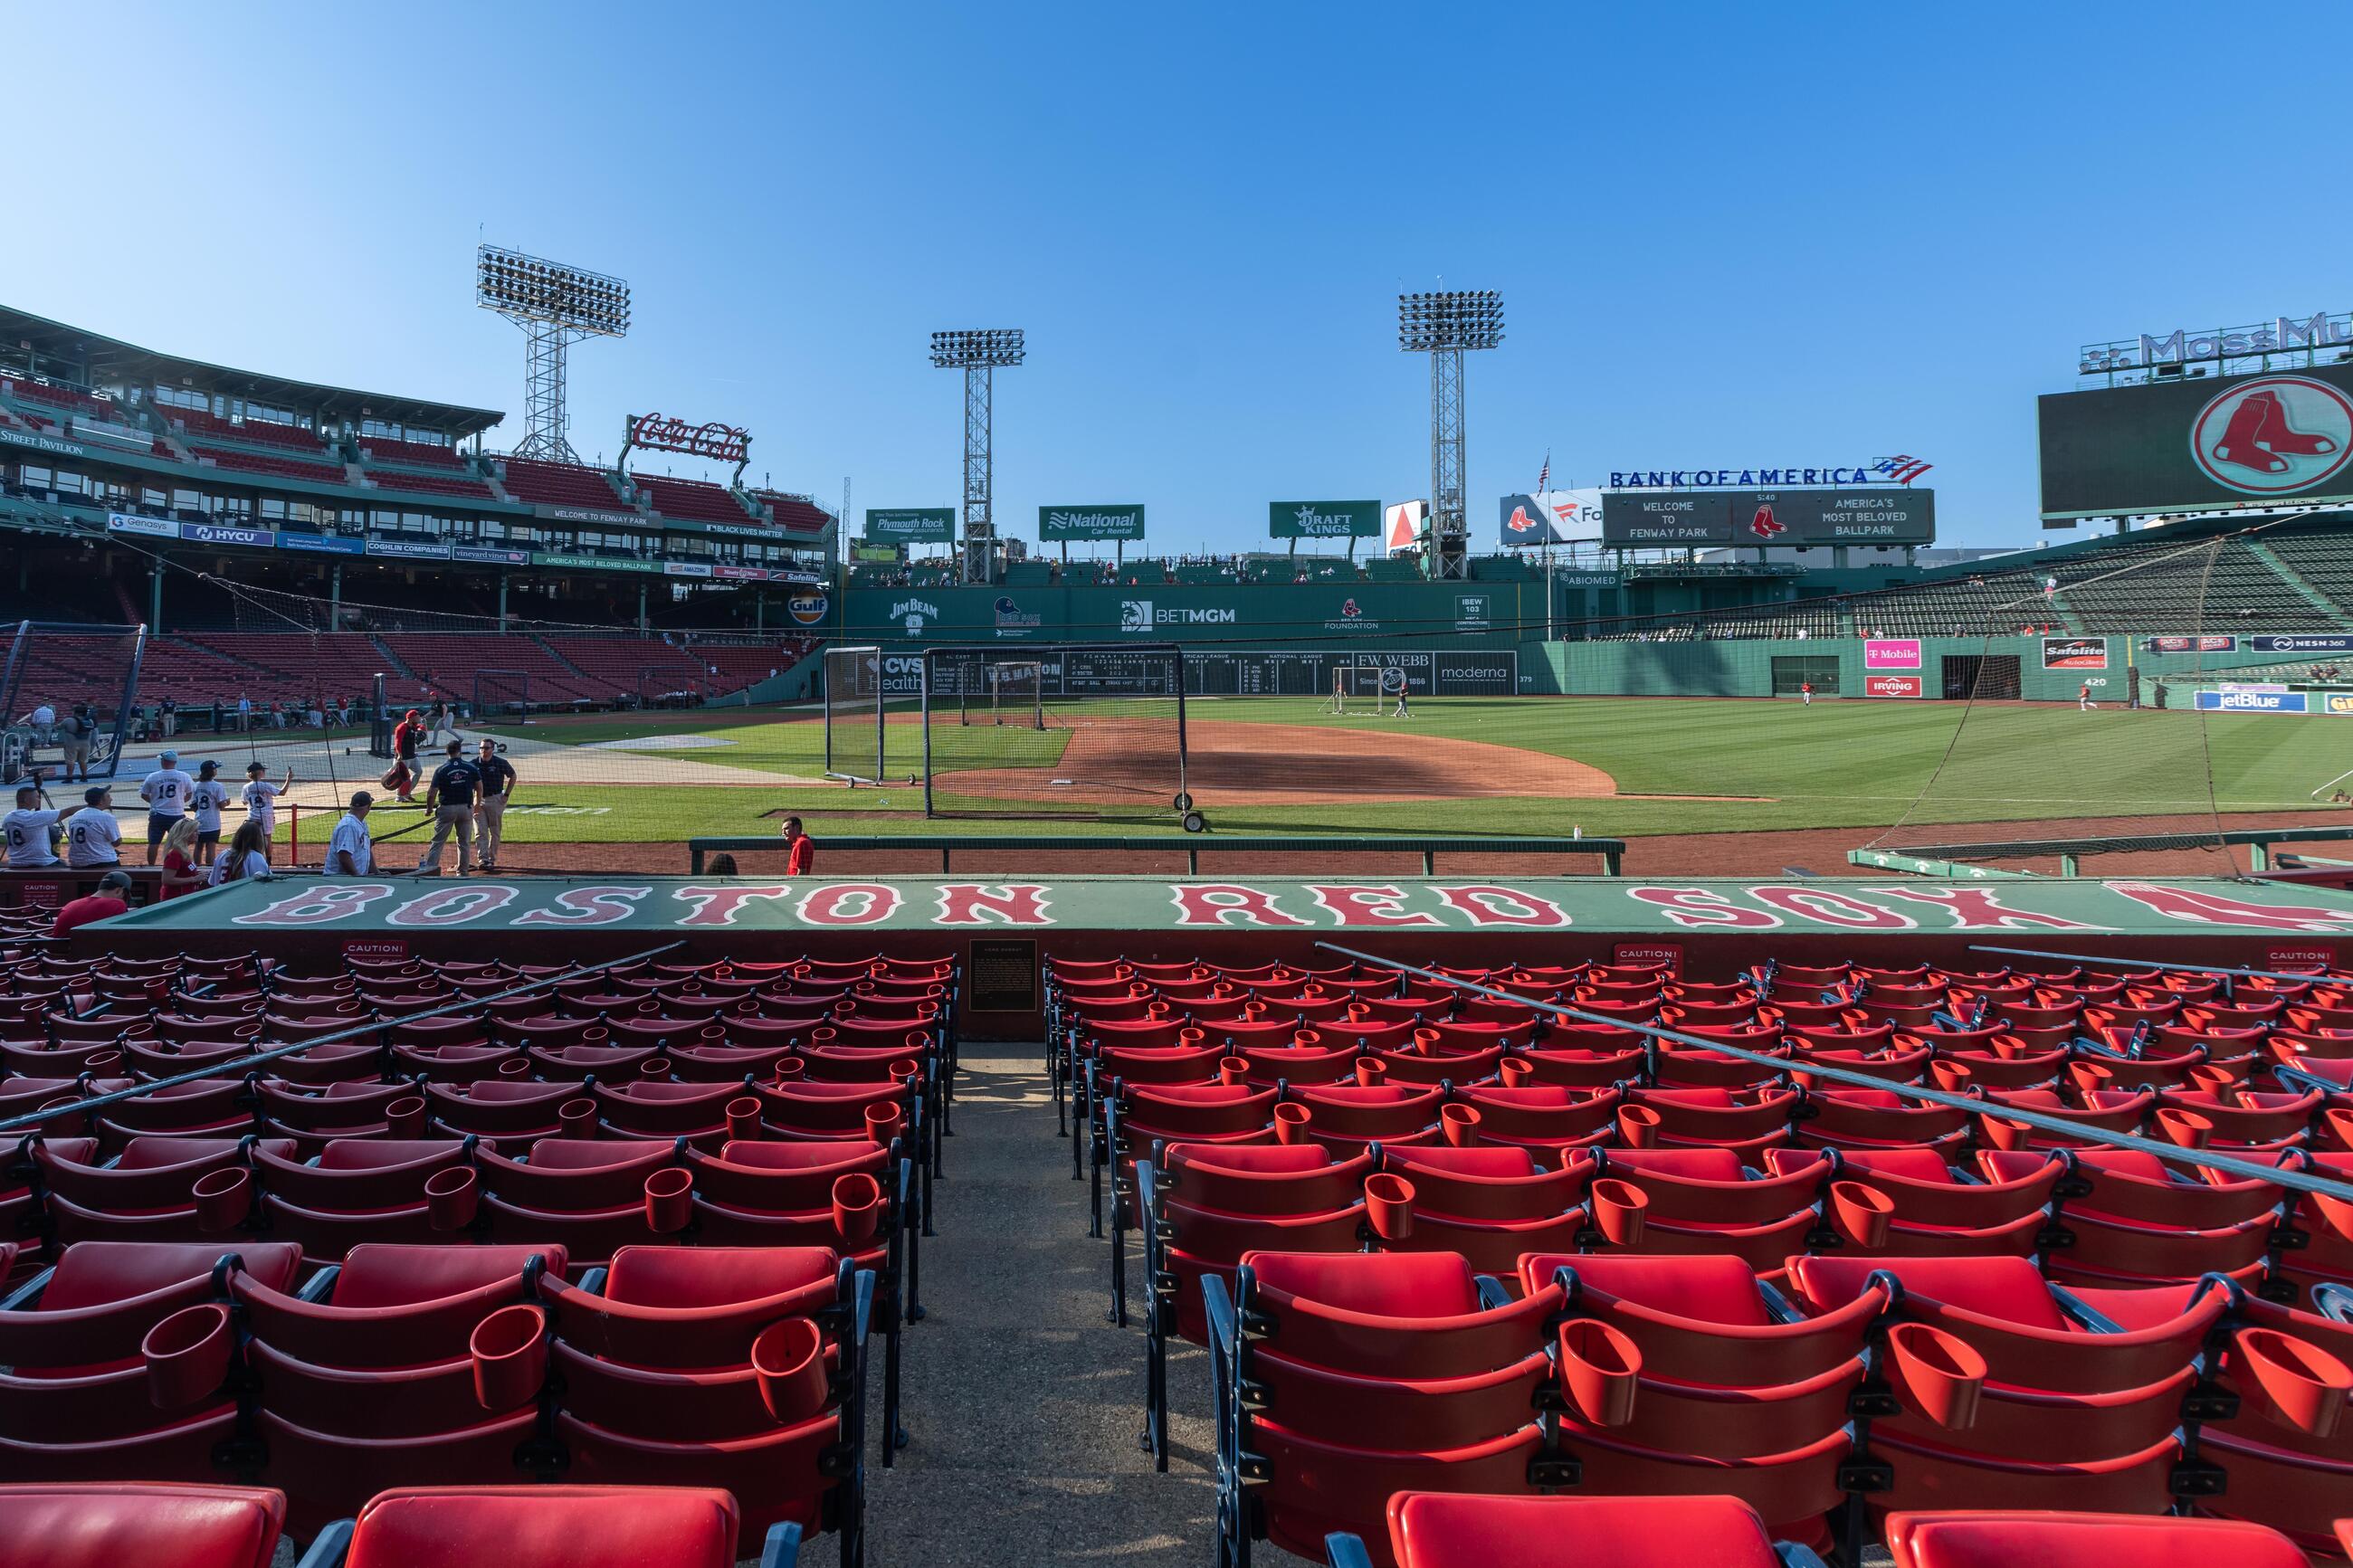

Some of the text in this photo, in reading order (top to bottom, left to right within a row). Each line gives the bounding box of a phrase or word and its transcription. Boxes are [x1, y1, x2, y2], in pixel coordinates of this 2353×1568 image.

[1, 430, 84, 455] STREET PAVILION
[1610, 467, 1868, 488] BANK OF AMERICA
[1643, 502, 1694, 512] WELCOME
[1835, 499, 1894, 508] AMERICA'S
[555, 510, 588, 520] WELCOME
[600, 514, 629, 523] FENWAY
[629, 517, 647, 525] PARK
[1298, 515, 1352, 527] DRAFT
[1662, 515, 1675, 524] TO
[1823, 512, 1907, 522] MOST BELOVED
[128, 517, 167, 530] Genasys
[877, 518, 944, 529] Plymouth Rock
[1305, 525, 1351, 534] KINGS
[215, 529, 255, 542] HYCU
[717, 525, 739, 534] BLACK
[759, 529, 783, 538] MATTER
[1630, 528, 1708, 538] FENWAY PARK
[1835, 526, 1894, 535] BALLPARK
[368, 542, 448, 554] COGHLIN COMPANIES
[456, 550, 488, 560] vineyard
[546, 557, 578, 565] AMERICA'S
[579, 559, 594, 567] MOST
[596, 561, 621, 569] BELOVED
[787, 573, 819, 582] Safelite
[1568, 576, 1616, 585] ABIOMED
[789, 599, 826, 612] Gulf
[890, 598, 939, 621] JIM BEAM
[1156, 609, 1235, 622] BETMGM
[1881, 649, 1918, 658] Mobile
[2046, 647, 2105, 655] Safelite
[885, 657, 923, 674] CVS
[1358, 654, 1430, 667] F.W. WEBB
[1442, 666, 1507, 678] moderna
[2085, 678, 2106, 686] 420
[2220, 694, 2280, 708] jetBlue
[157, 784, 176, 799] 18
[232, 883, 2124, 930] BOSTON RED SOX
